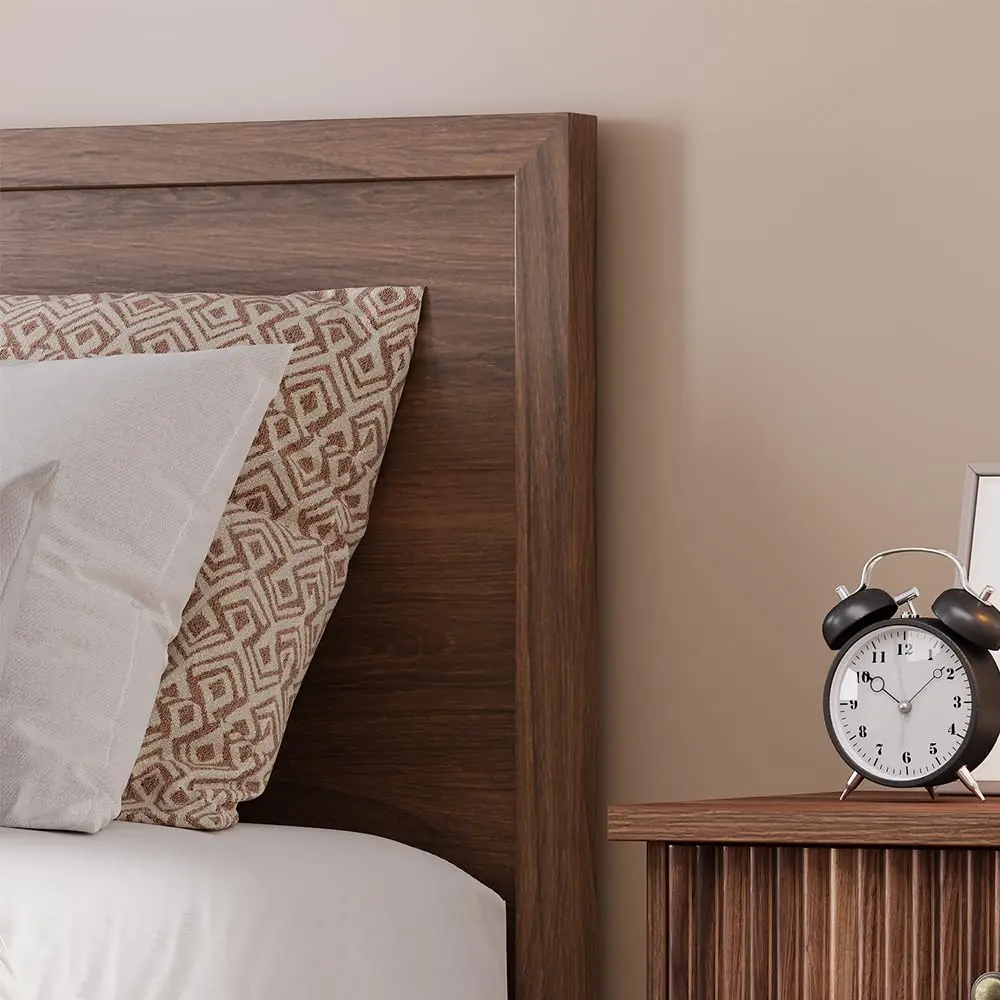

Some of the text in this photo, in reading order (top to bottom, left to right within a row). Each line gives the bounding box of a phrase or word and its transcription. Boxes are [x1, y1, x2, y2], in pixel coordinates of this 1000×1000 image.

[896, 643, 913, 656] 12
[927, 649, 934, 661] 1
[871, 651, 886, 664] 11
[856, 671, 870, 683] 10
[946, 668, 955, 680] 2
[849, 700, 858, 710] 9
[953, 696, 962, 708] 3
[858, 725, 867, 738] 8
[947, 723, 956, 735] 4
[875, 743, 884, 756] 7
[929, 742, 938, 755] 5
[902, 751, 912, 763] 6
